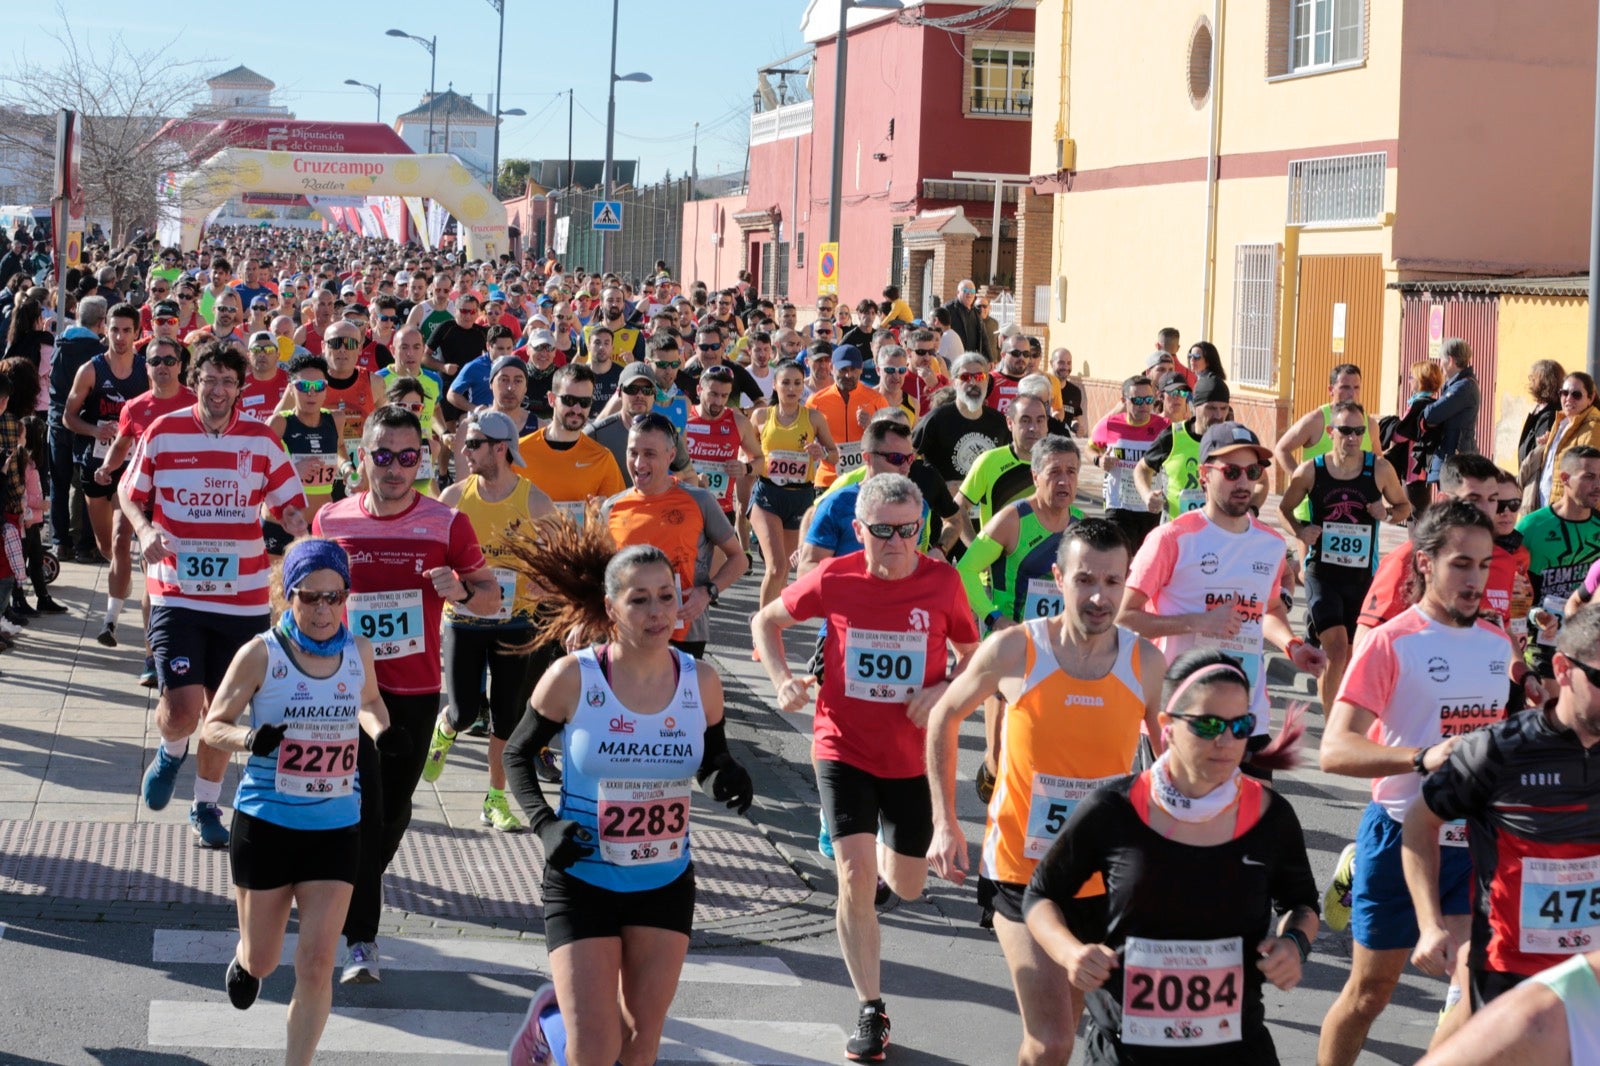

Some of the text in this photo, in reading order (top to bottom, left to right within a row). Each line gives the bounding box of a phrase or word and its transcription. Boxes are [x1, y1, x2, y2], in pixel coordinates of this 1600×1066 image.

[291, 128, 345, 140] Diputación
[290, 140, 345, 152] de Granada
[293, 158, 385, 176] Cruzcampo
[302, 178, 345, 191] Radler
[769, 460, 807, 477] 2064
[839, 452, 862, 467] 300
[204, 476, 239, 489] Sierra
[176, 488, 247, 508] Cazorla
[187, 507, 212, 519] Agua
[1329, 536, 1363, 553] 289
[186, 556, 230, 577] 367
[1542, 566, 1573, 588] TEAM
[1036, 597, 1065, 618] 61
[360, 611, 409, 639] 951
[858, 652, 912, 680] 590
[283, 704, 357, 719] MARACENA
[1440, 699, 1499, 720] BABOLÉ
[282, 743, 356, 773] 2276
[597, 740, 694, 758] MARACENA
[624, 781, 641, 790] GRAN
[641, 780, 662, 790] PREMIO
[1057, 779, 1074, 788] GRAN
[1075, 780, 1098, 790] PREMIO
[603, 802, 686, 838] 2283
[1130, 971, 1238, 1012] 2084
